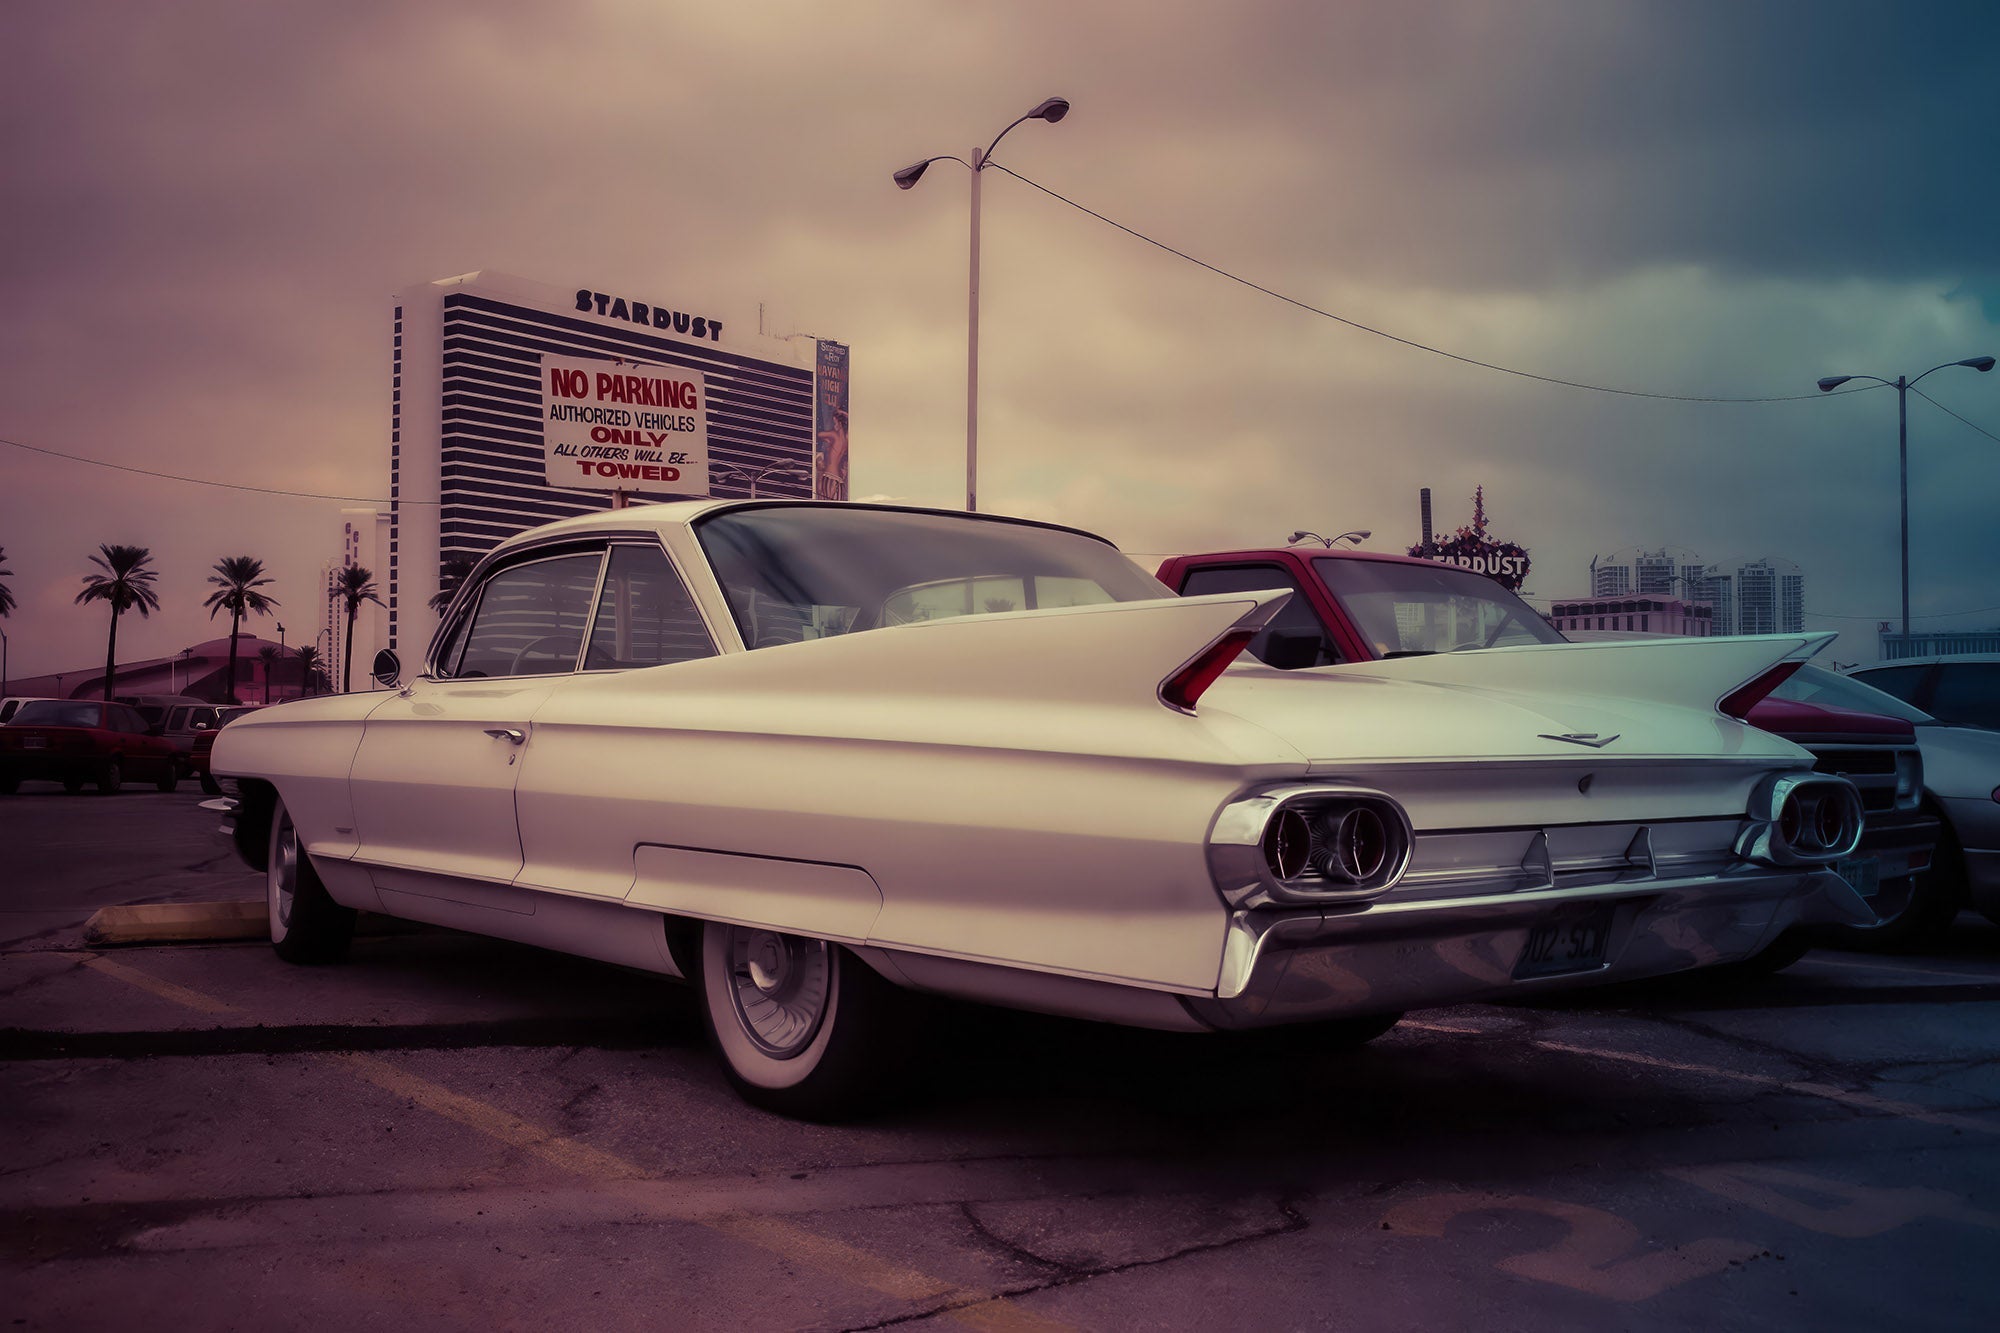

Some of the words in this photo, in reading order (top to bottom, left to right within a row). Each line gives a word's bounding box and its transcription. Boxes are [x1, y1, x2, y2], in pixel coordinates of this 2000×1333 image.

[575, 289, 722, 341] STARDUST
[551, 368, 588, 399] NO
[596, 373, 697, 410] PARKING
[550, 404, 631, 427] AUTHORIZED
[634, 411, 695, 432] VEHICLES
[590, 426, 668, 447] ONLY
[553, 443, 578, 457] ALL
[581, 445, 629, 460] OTHERS
[634, 448, 663, 462] WILL
[576, 460, 681, 481] TOWED
